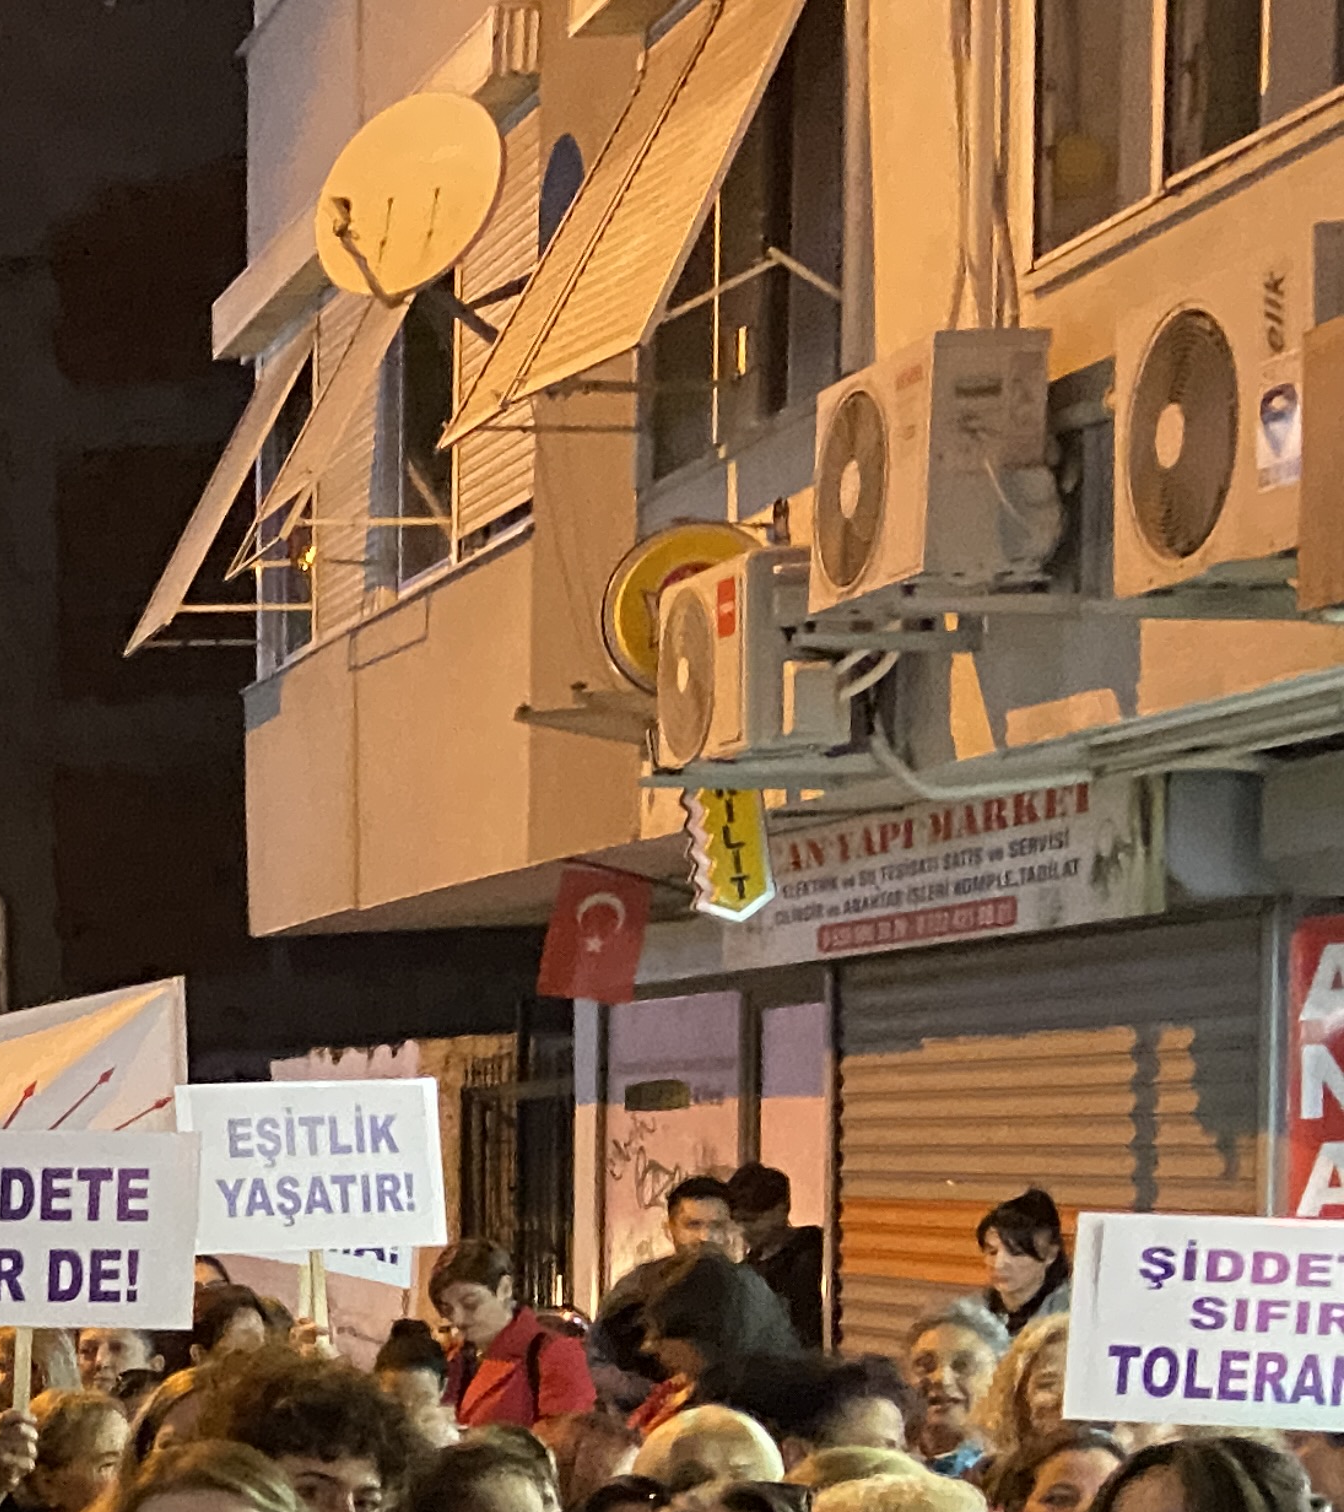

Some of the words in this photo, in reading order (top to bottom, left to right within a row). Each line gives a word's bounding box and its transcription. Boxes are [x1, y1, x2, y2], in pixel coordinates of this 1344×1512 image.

[226, 1103, 399, 1169] EŞİTLİK
[216, 1171, 416, 1228] YAŞATIR!
[47, 1248, 140, 1302] DE!
[1138, 1240, 1344, 1289] ŞİDDE
[1190, 1296, 1344, 1337] SIFIR
